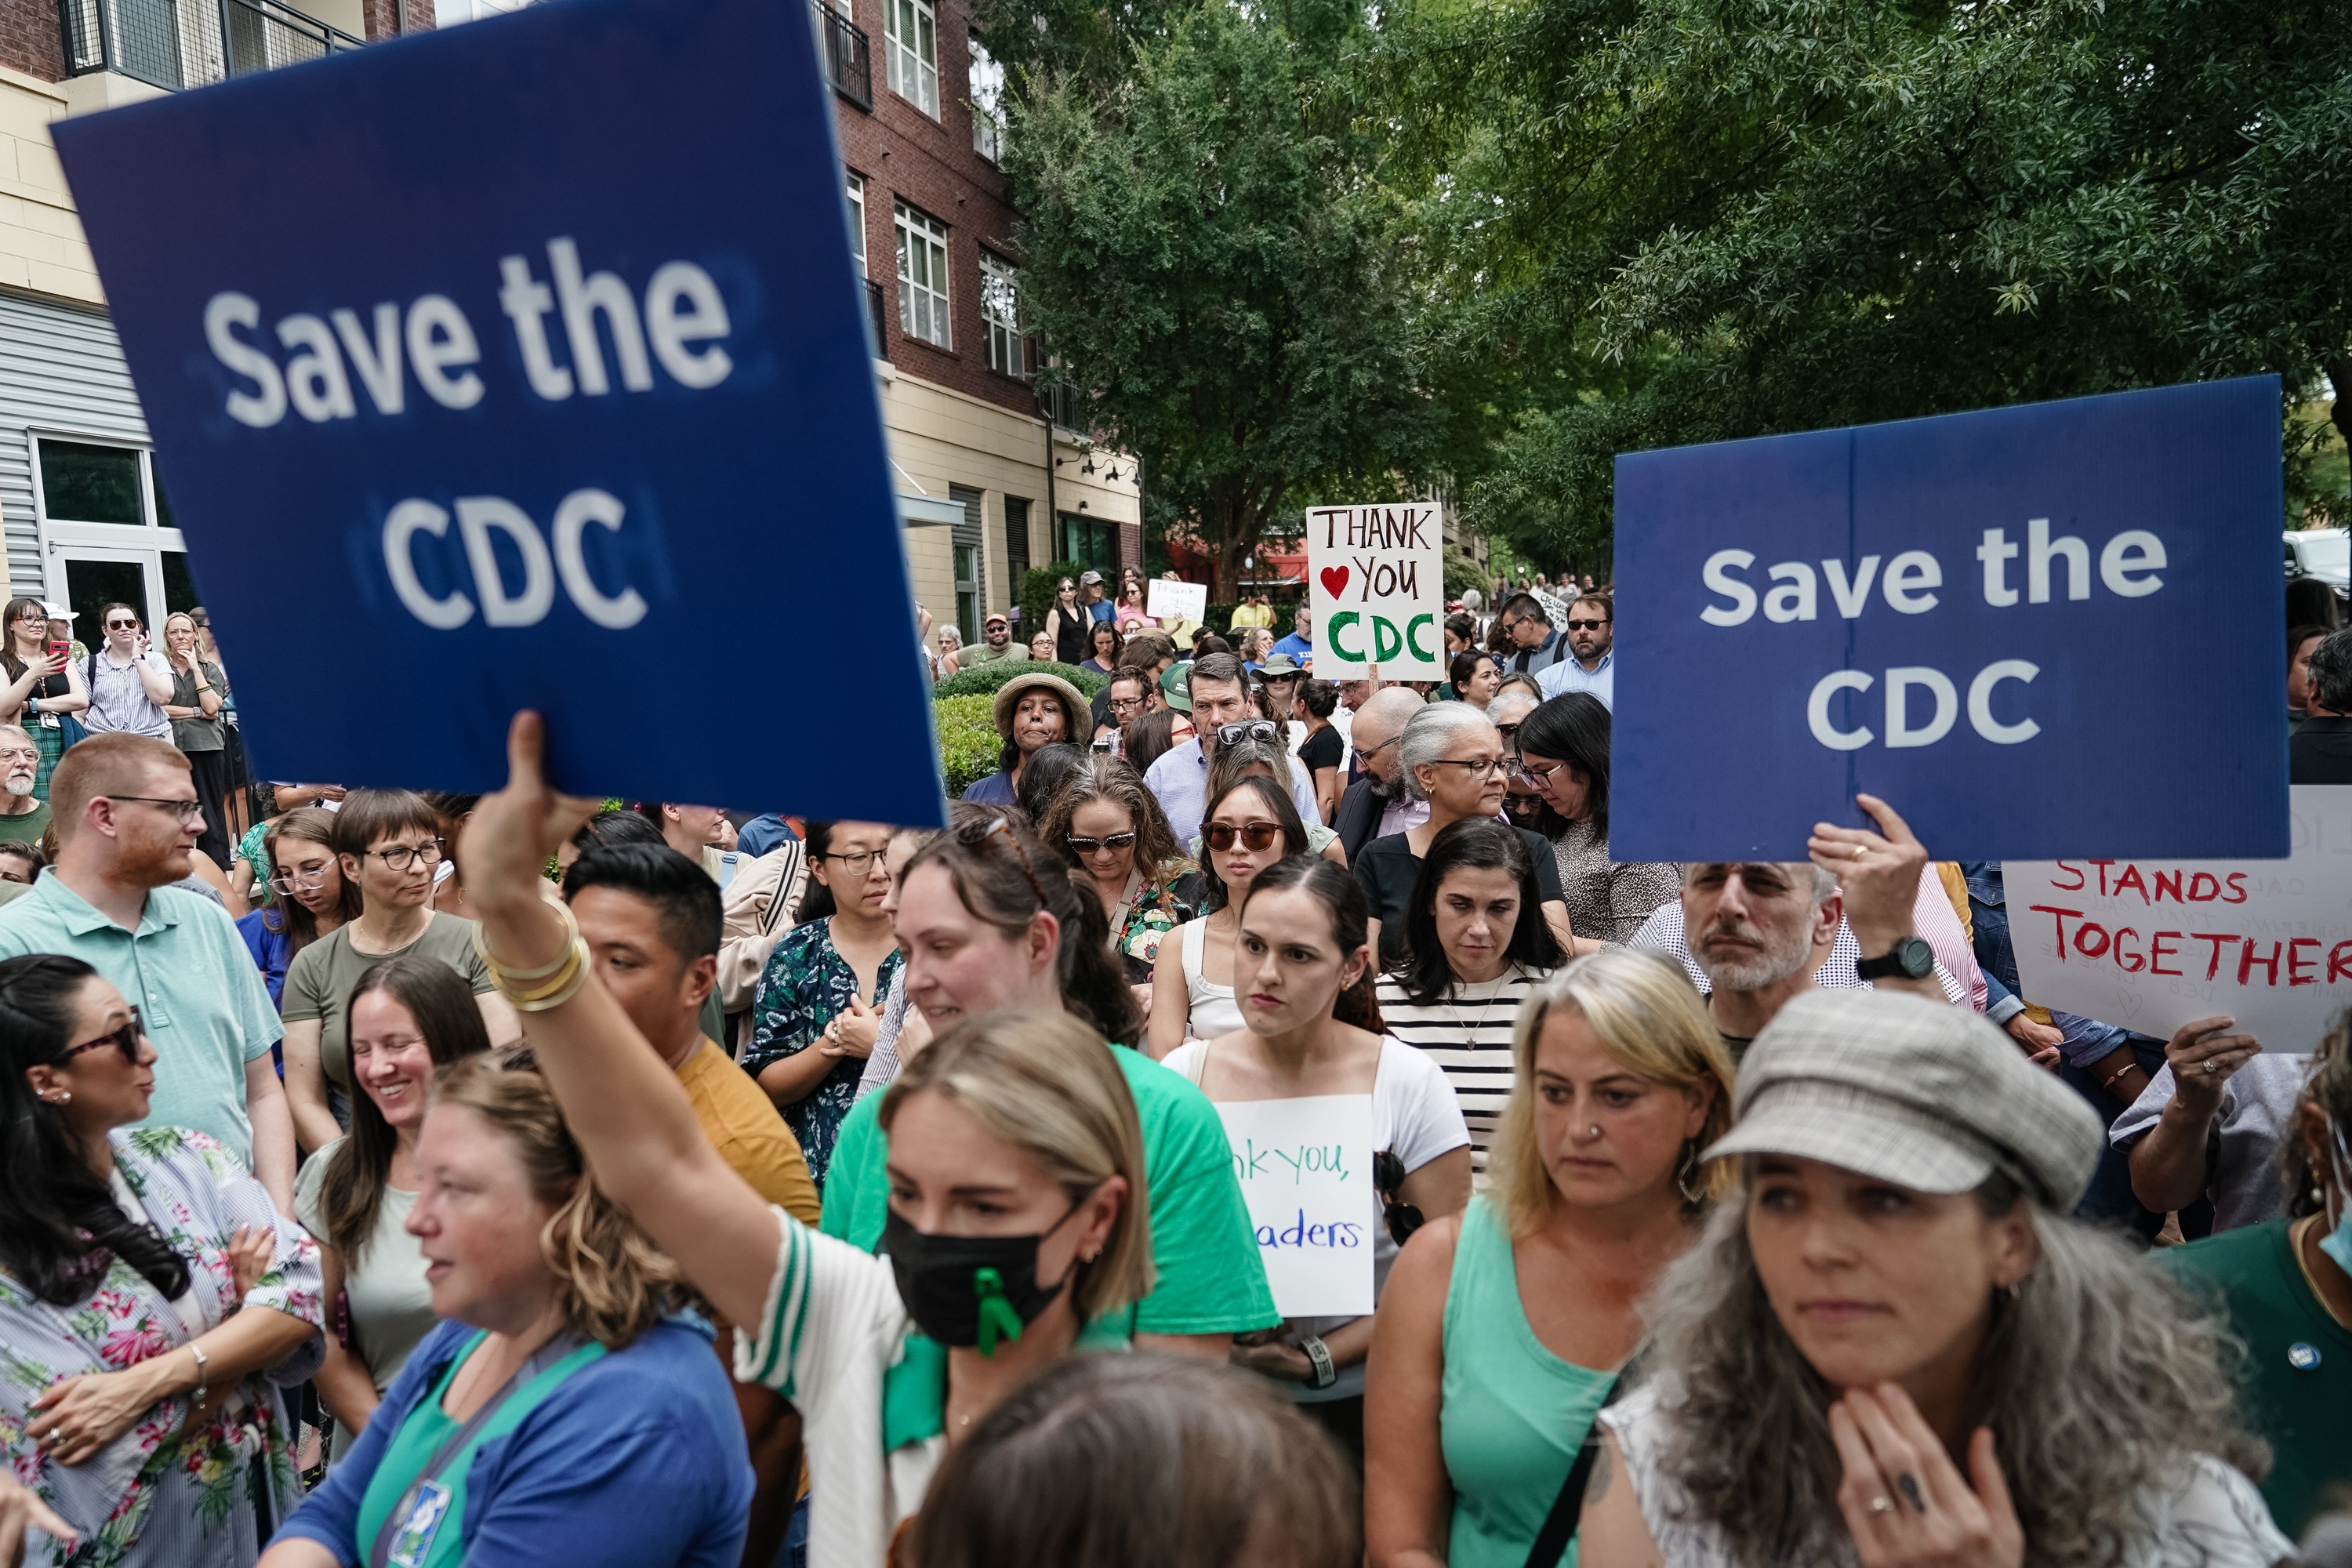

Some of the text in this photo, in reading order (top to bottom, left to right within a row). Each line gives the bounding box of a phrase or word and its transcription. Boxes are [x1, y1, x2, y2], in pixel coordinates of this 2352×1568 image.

[203, 238, 731, 427] Save the
[1312, 508, 1433, 550] THANK
[382, 488, 648, 629] CDC
[1352, 556, 1419, 602] YOU
[1700, 518, 2168, 627] Save the
[1156, 583, 1196, 596] Thank
[1328, 611, 1436, 662] CDC
[1806, 659, 2042, 751] CDC
[2050, 860, 2249, 906] STANDS
[2029, 904, 2352, 986] TOGETHER
[1274, 1145, 1348, 1185] you,
[1256, 1208, 1363, 1249] aders
